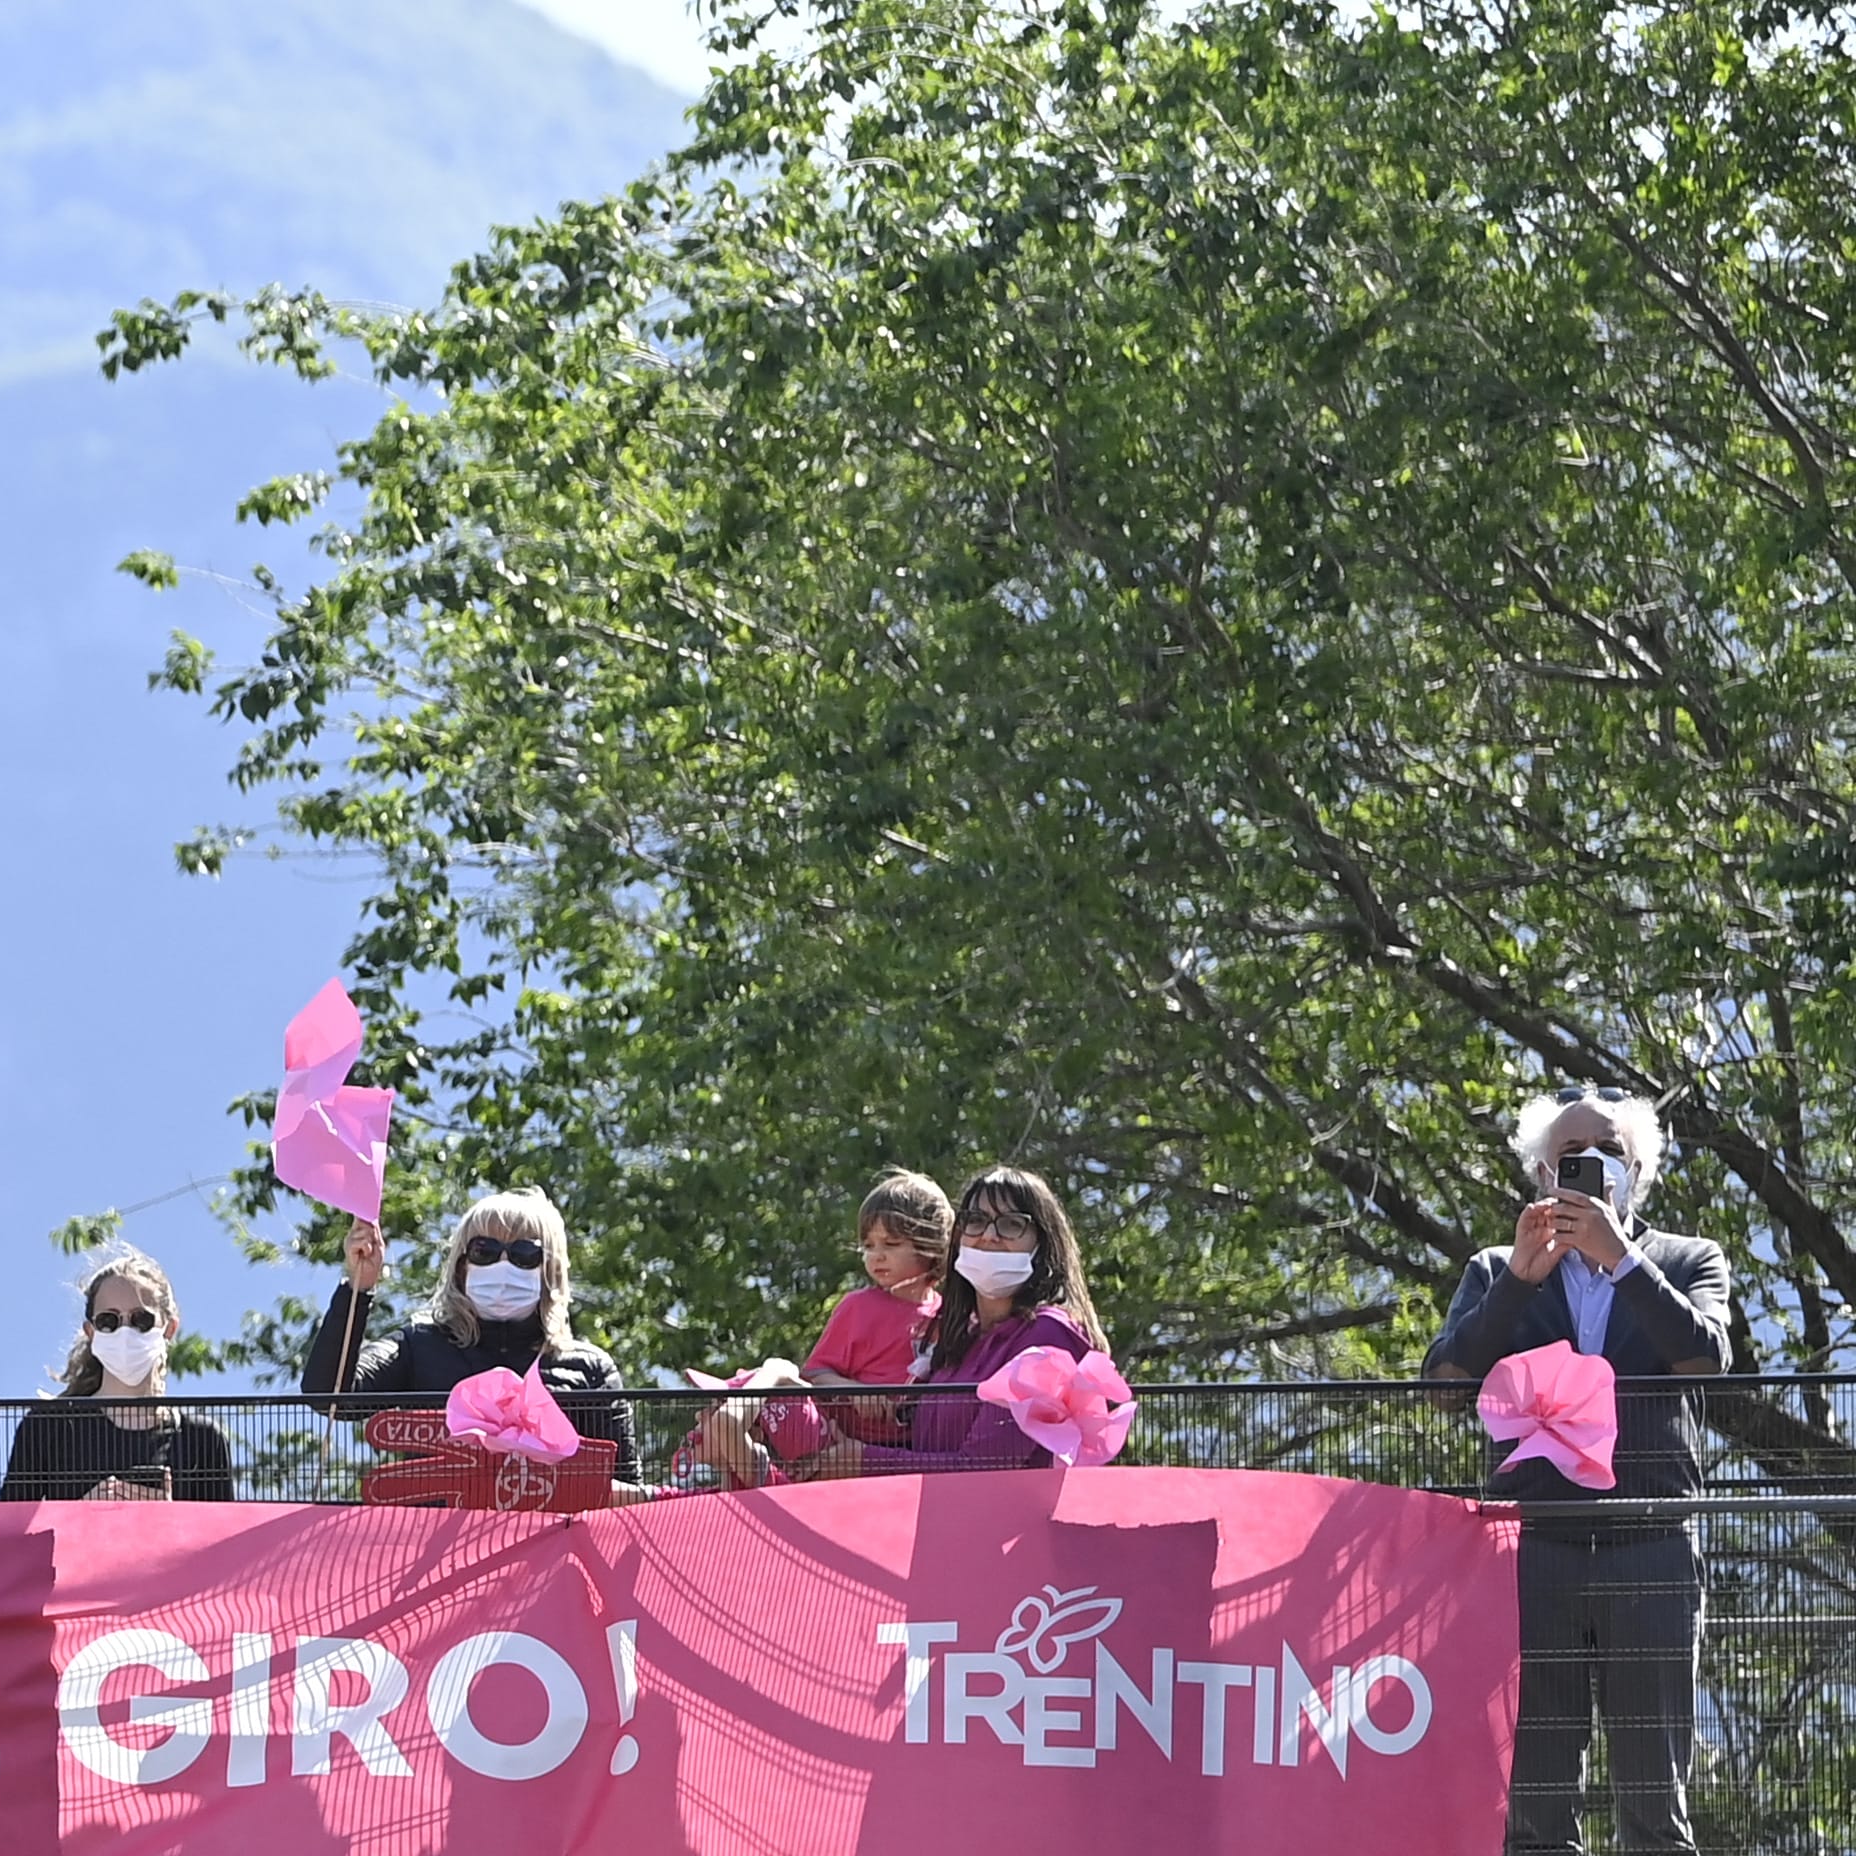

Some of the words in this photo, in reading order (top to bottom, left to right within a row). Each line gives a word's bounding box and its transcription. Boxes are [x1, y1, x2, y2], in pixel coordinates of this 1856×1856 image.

[386, 1421, 447, 1443] YOTA
[58, 1618, 639, 1788] GIRO!
[876, 1621, 1433, 1782] TRENTINO
